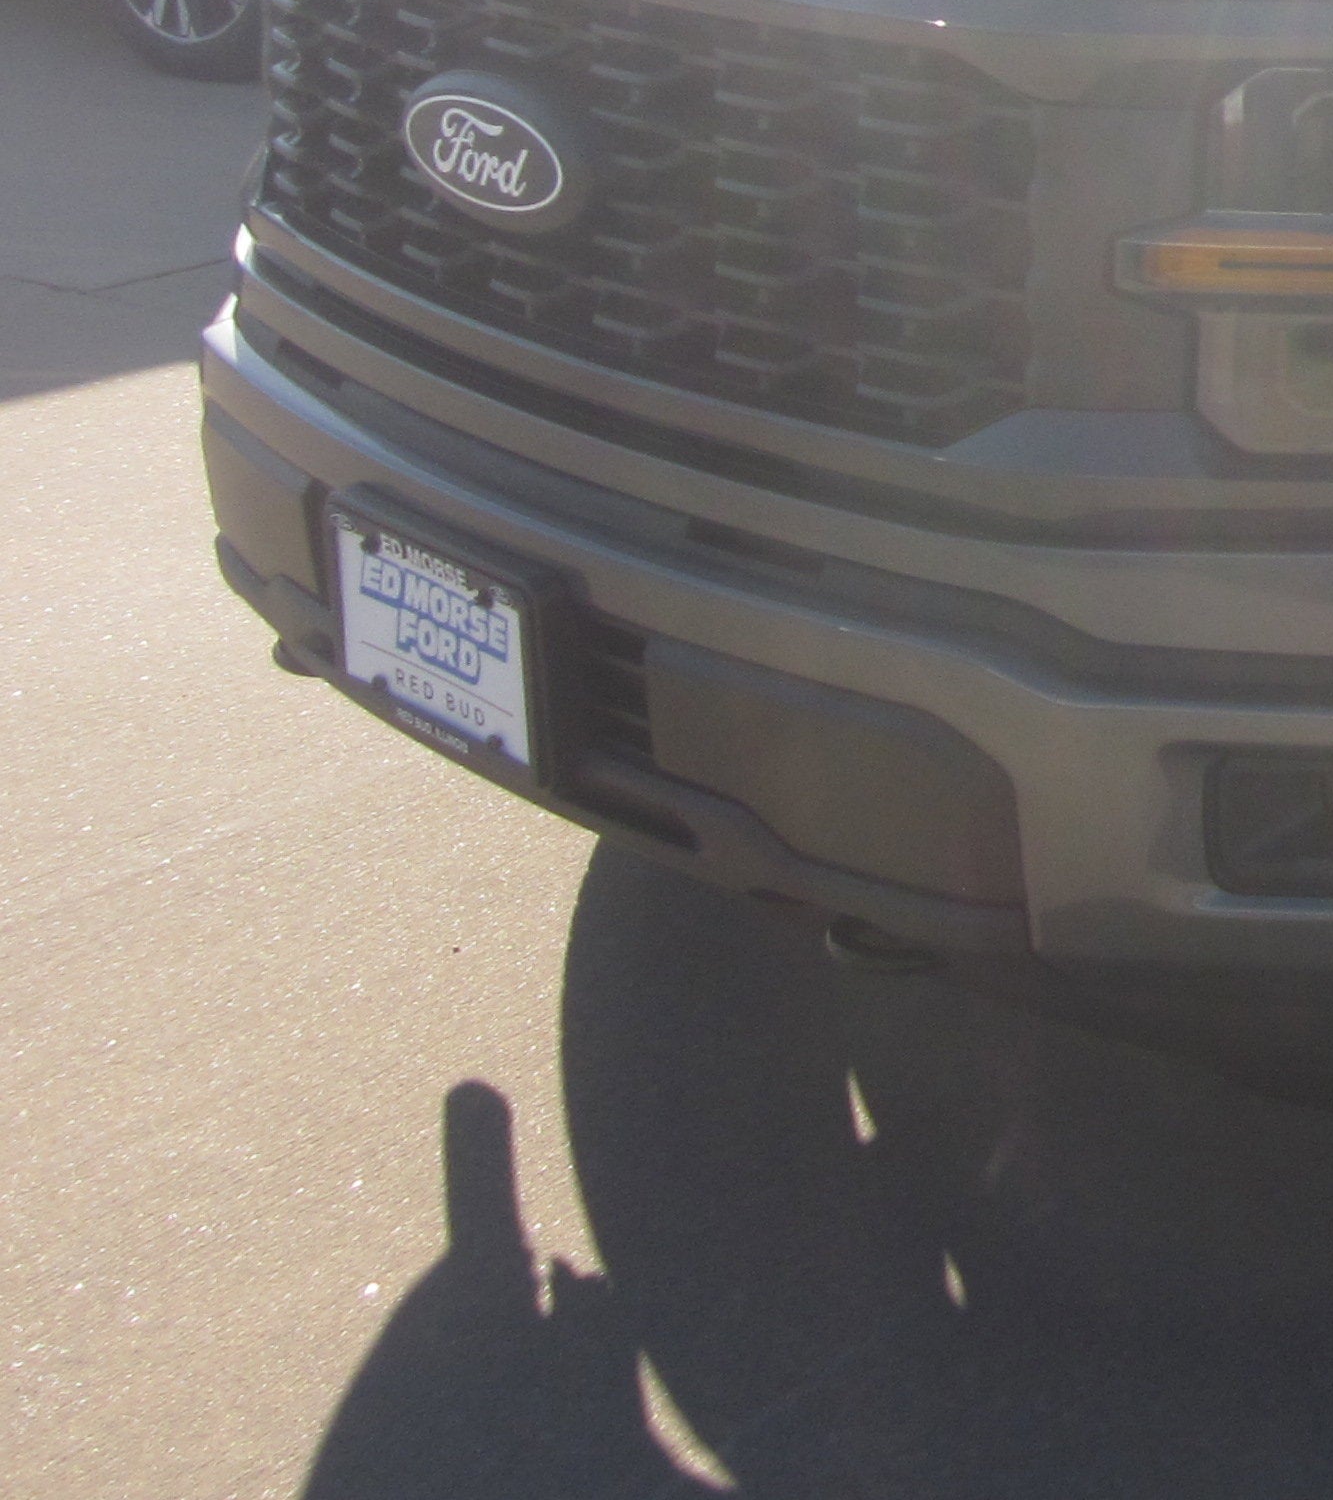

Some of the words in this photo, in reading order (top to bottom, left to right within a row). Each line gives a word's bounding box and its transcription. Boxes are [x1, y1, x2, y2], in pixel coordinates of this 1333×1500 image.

[433, 107, 528, 197] Ford
[361, 553, 402, 604] ED
[403, 568, 508, 660] MORSE
[398, 605, 481, 684] FORD
[396, 668, 434, 700] RED
[446, 692, 485, 726] BUD
